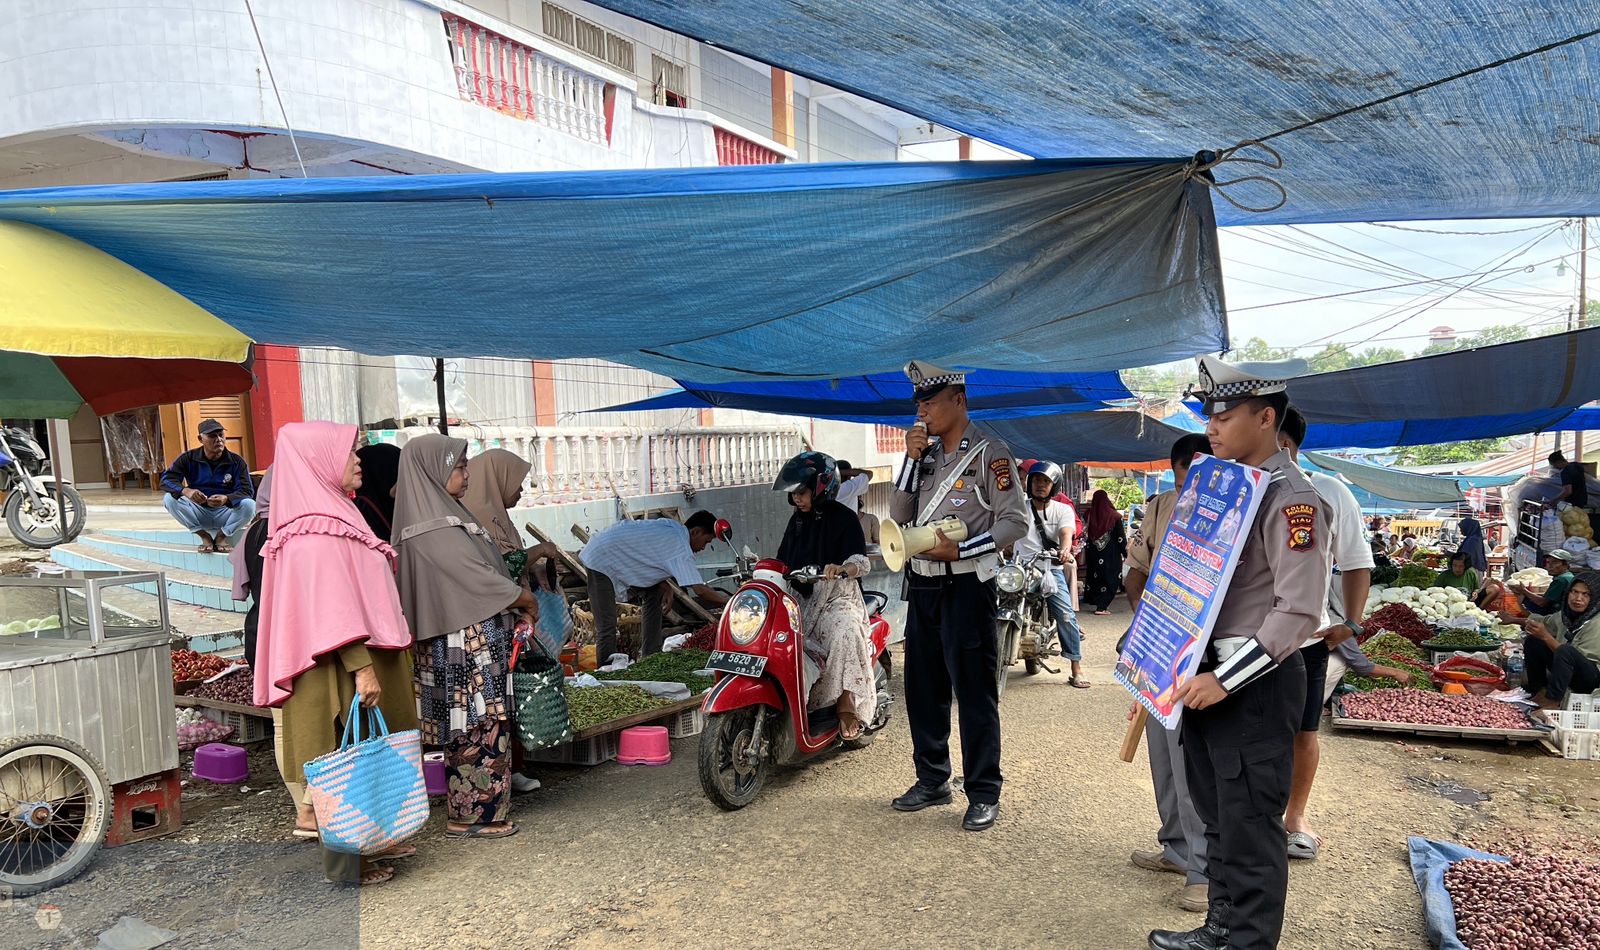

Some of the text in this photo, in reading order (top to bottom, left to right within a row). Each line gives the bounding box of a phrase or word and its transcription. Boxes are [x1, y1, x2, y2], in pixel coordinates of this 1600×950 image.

[1290, 517, 1311, 525] RIAU
[1165, 530, 1195, 556] COOLING
[1191, 544, 1225, 572] SYSTEM
[711, 651, 725, 660] BM
[728, 653, 752, 665] 5620
